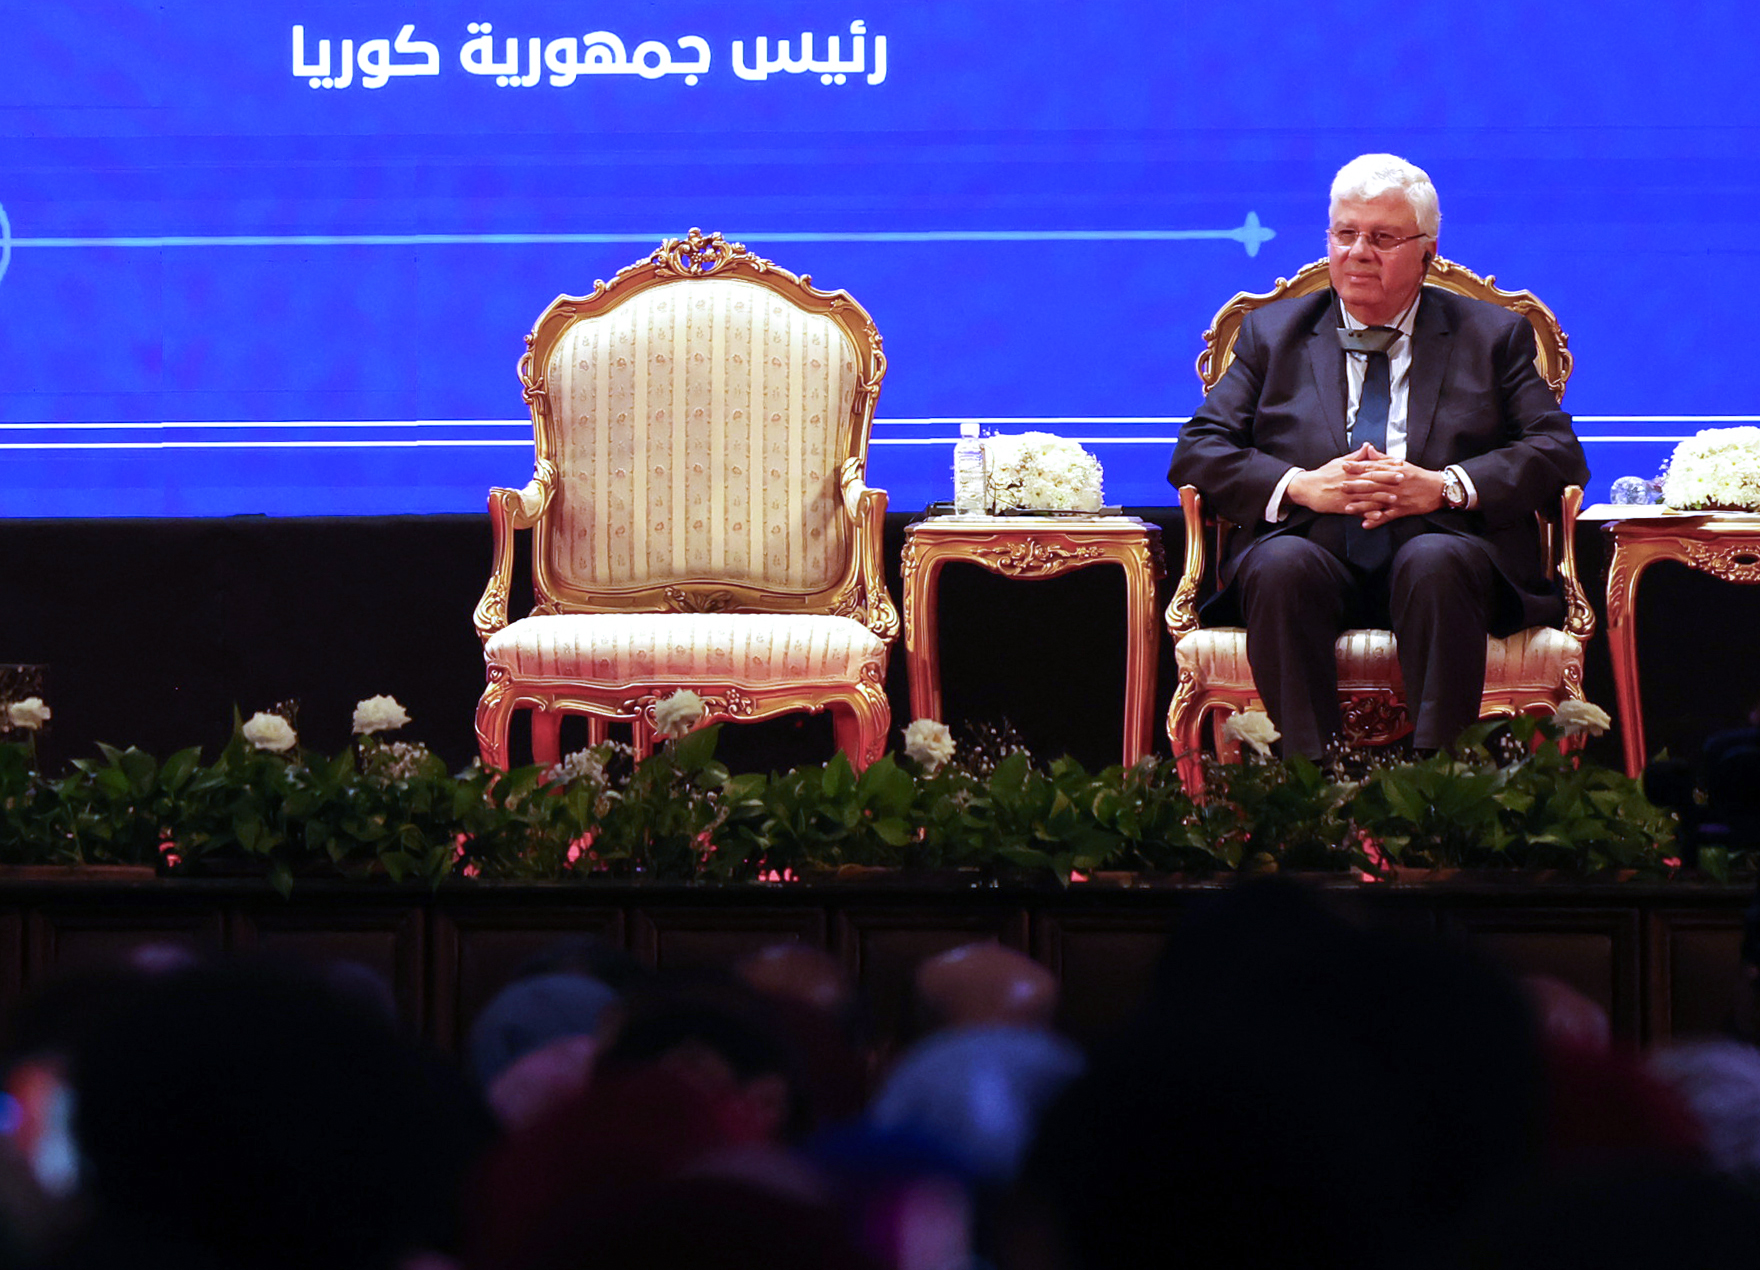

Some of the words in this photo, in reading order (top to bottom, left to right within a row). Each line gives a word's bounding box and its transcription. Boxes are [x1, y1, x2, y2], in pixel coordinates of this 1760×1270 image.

[292, 24, 440, 89] كوريا
[459, 21, 712, 88] جمهورية
[731, 19, 887, 86] رئيس
